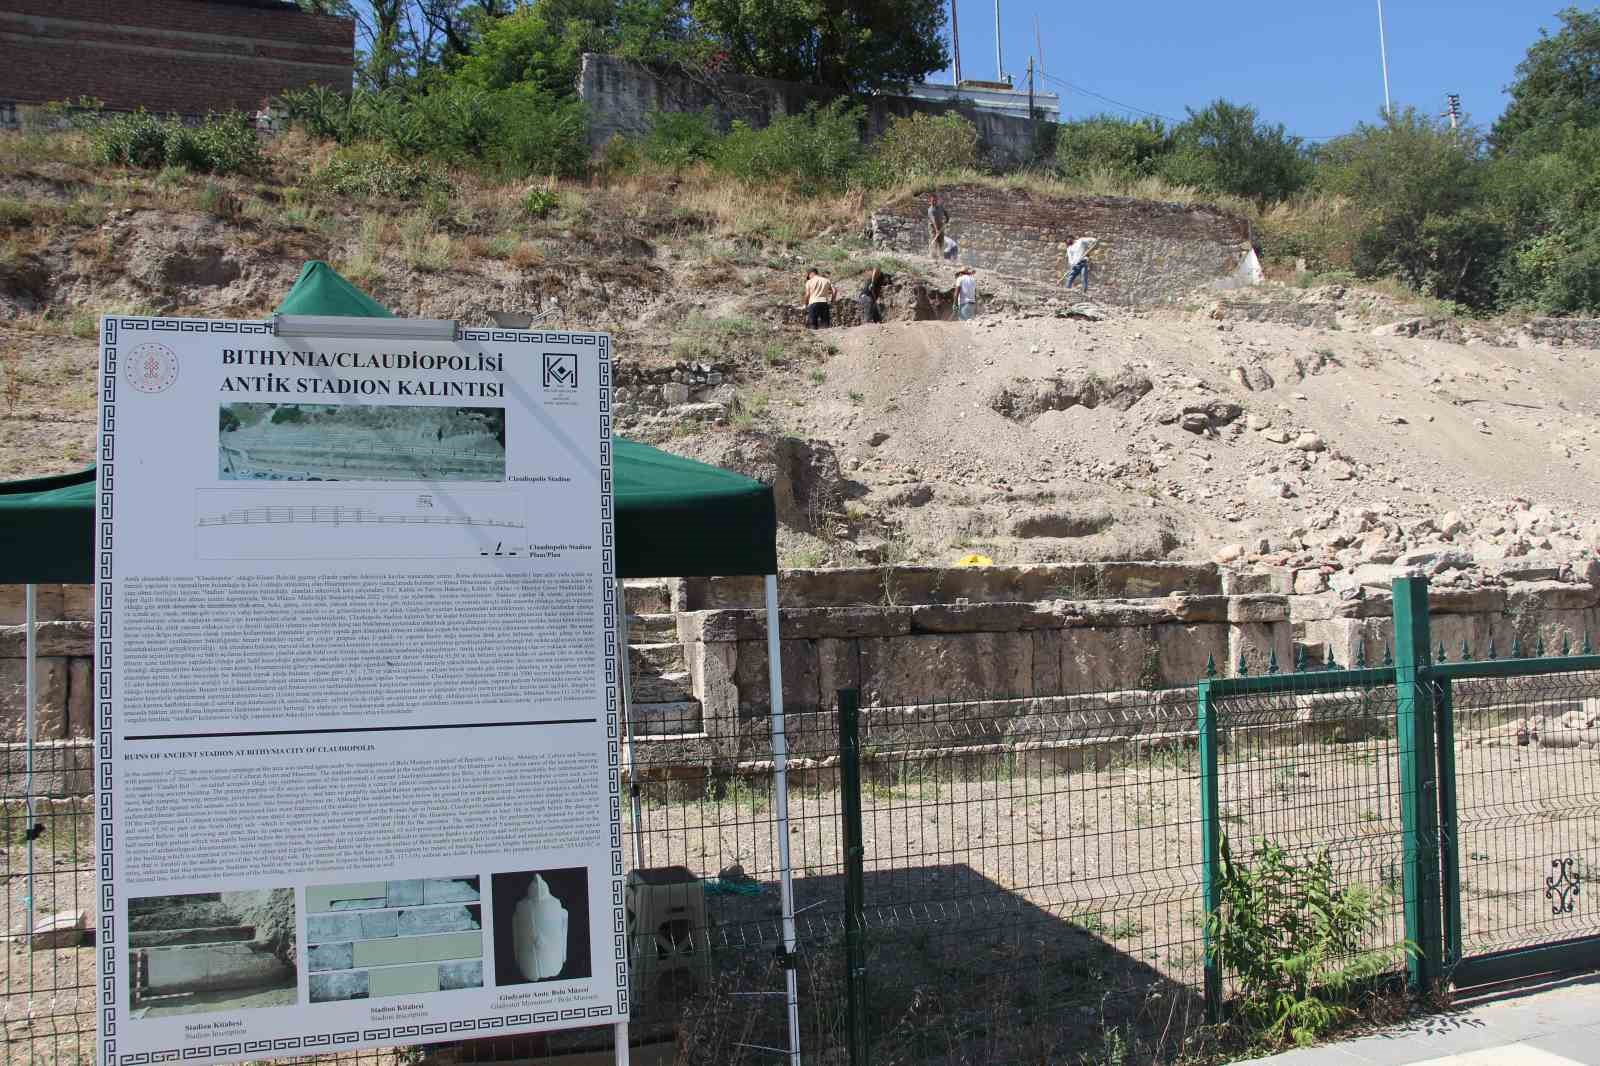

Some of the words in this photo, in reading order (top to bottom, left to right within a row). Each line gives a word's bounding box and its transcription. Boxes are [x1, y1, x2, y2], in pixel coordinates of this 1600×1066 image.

[223, 349, 505, 371] BITHYNIA/CLAUDİOPOLİSİ
[220, 372, 291, 393] ANTİK
[297, 378, 391, 395] STADION
[398, 380, 505, 397] KALINTISI
[124, 752, 149, 761] RUINS
[150, 752, 160, 760] OF
[163, 751, 198, 760] ANCIENT
[199, 749, 234, 758] STADION
[317, 744, 376, 753] CLAUDIOPOLIS
